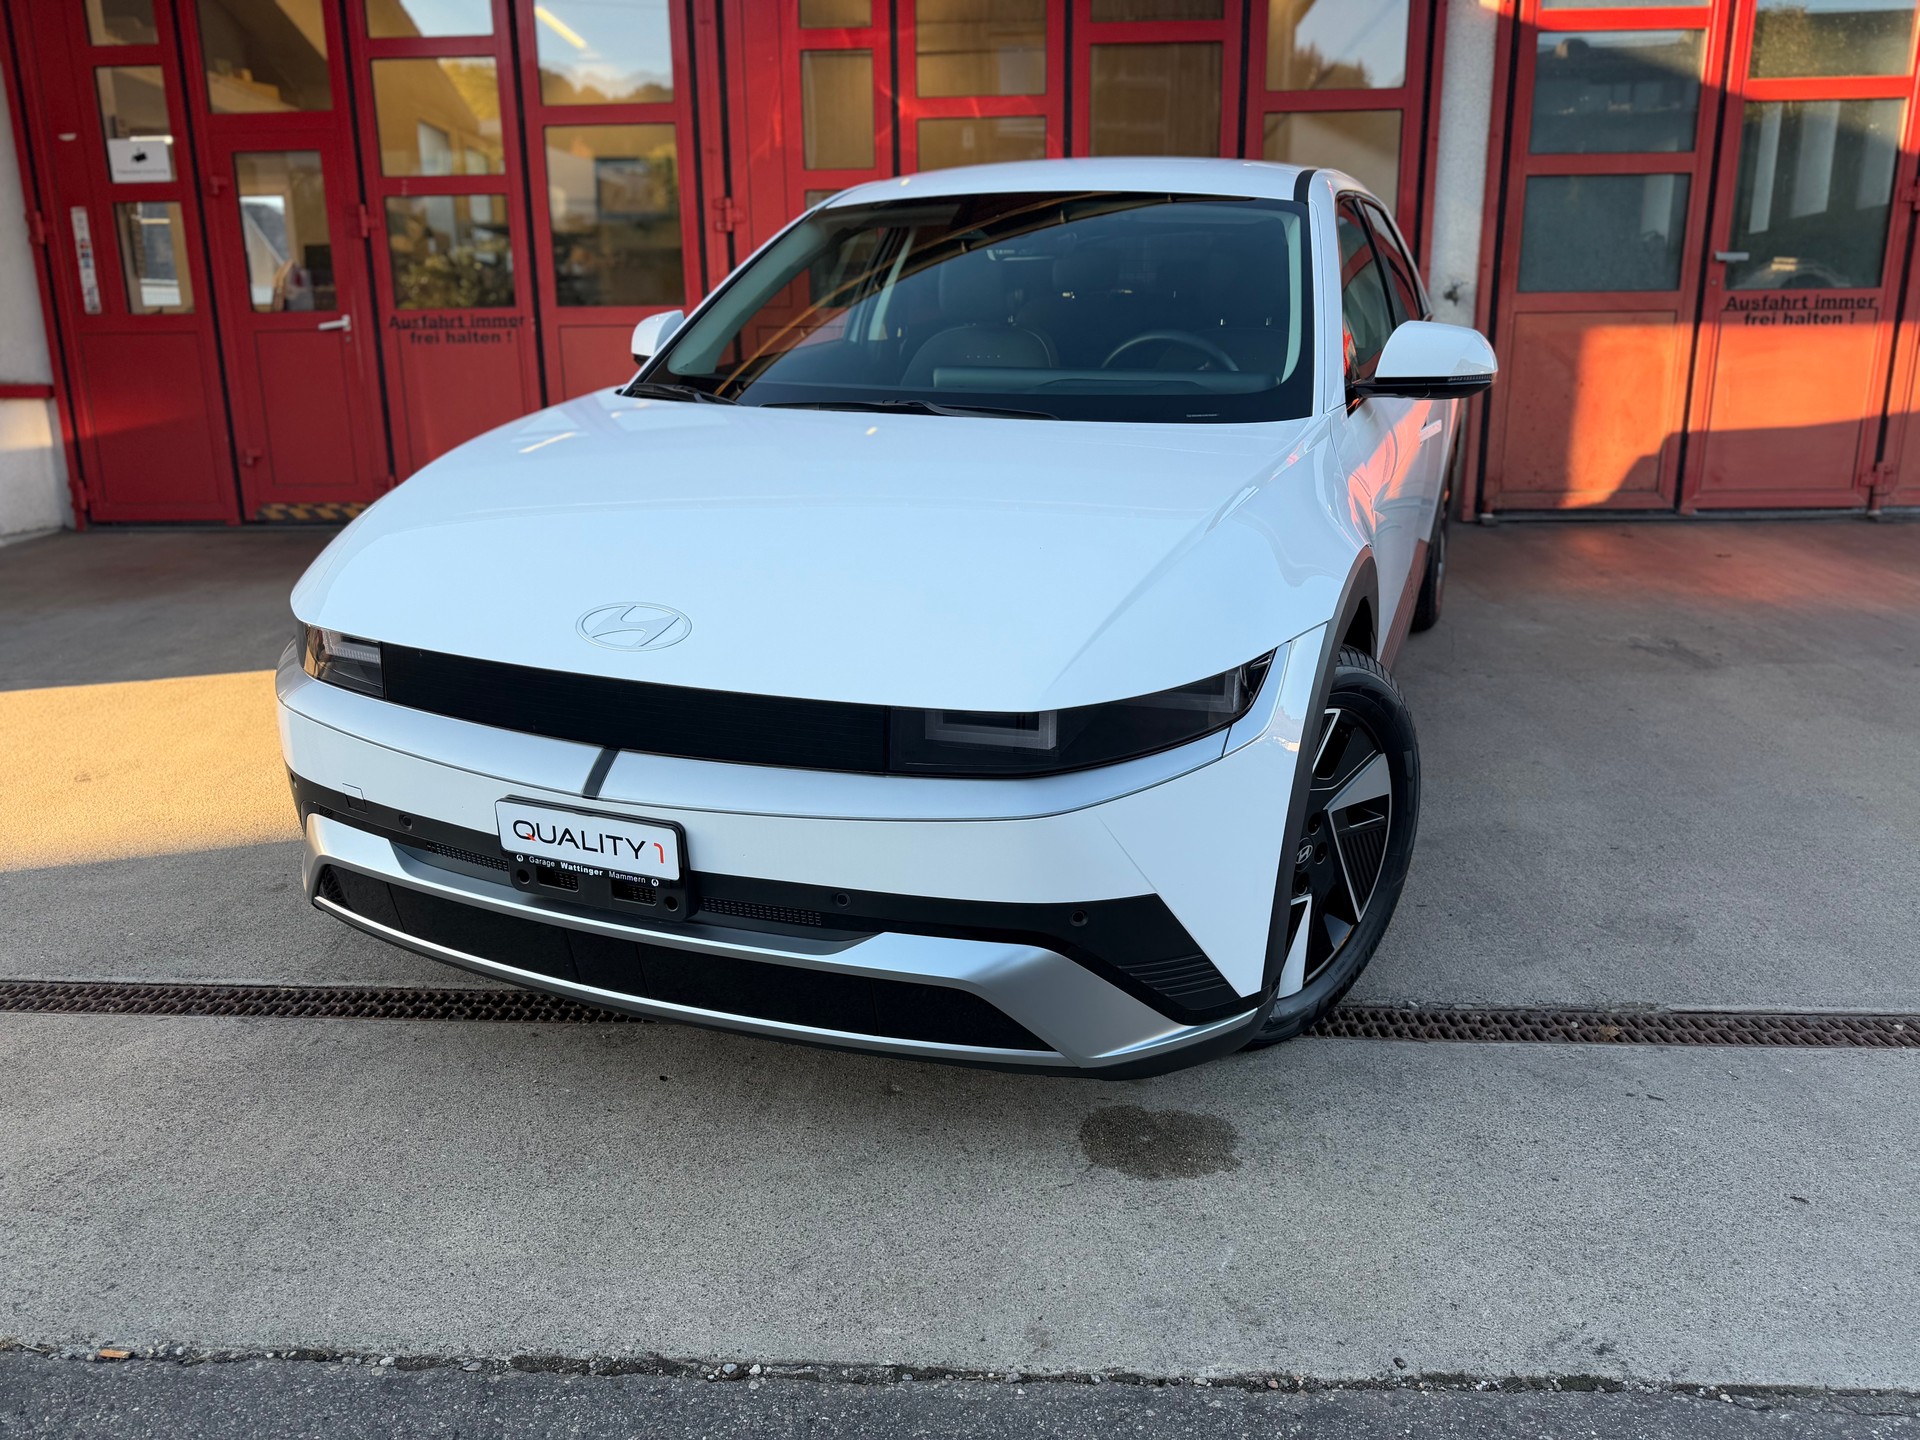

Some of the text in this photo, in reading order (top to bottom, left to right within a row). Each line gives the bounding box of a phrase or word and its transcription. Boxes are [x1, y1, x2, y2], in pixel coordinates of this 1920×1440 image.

[1725, 295, 1876, 311] Ausfahrt immer
[389, 314, 524, 330] Ausfahrt immer
[1744, 312, 1776, 326] frei
[1782, 312, 1843, 325] halten
[410, 331, 440, 344] frei
[446, 331, 502, 344] halten
[512, 819, 665, 864] QUALITY 1
[528, 855, 647, 884] Garage Wattinger Mammern
